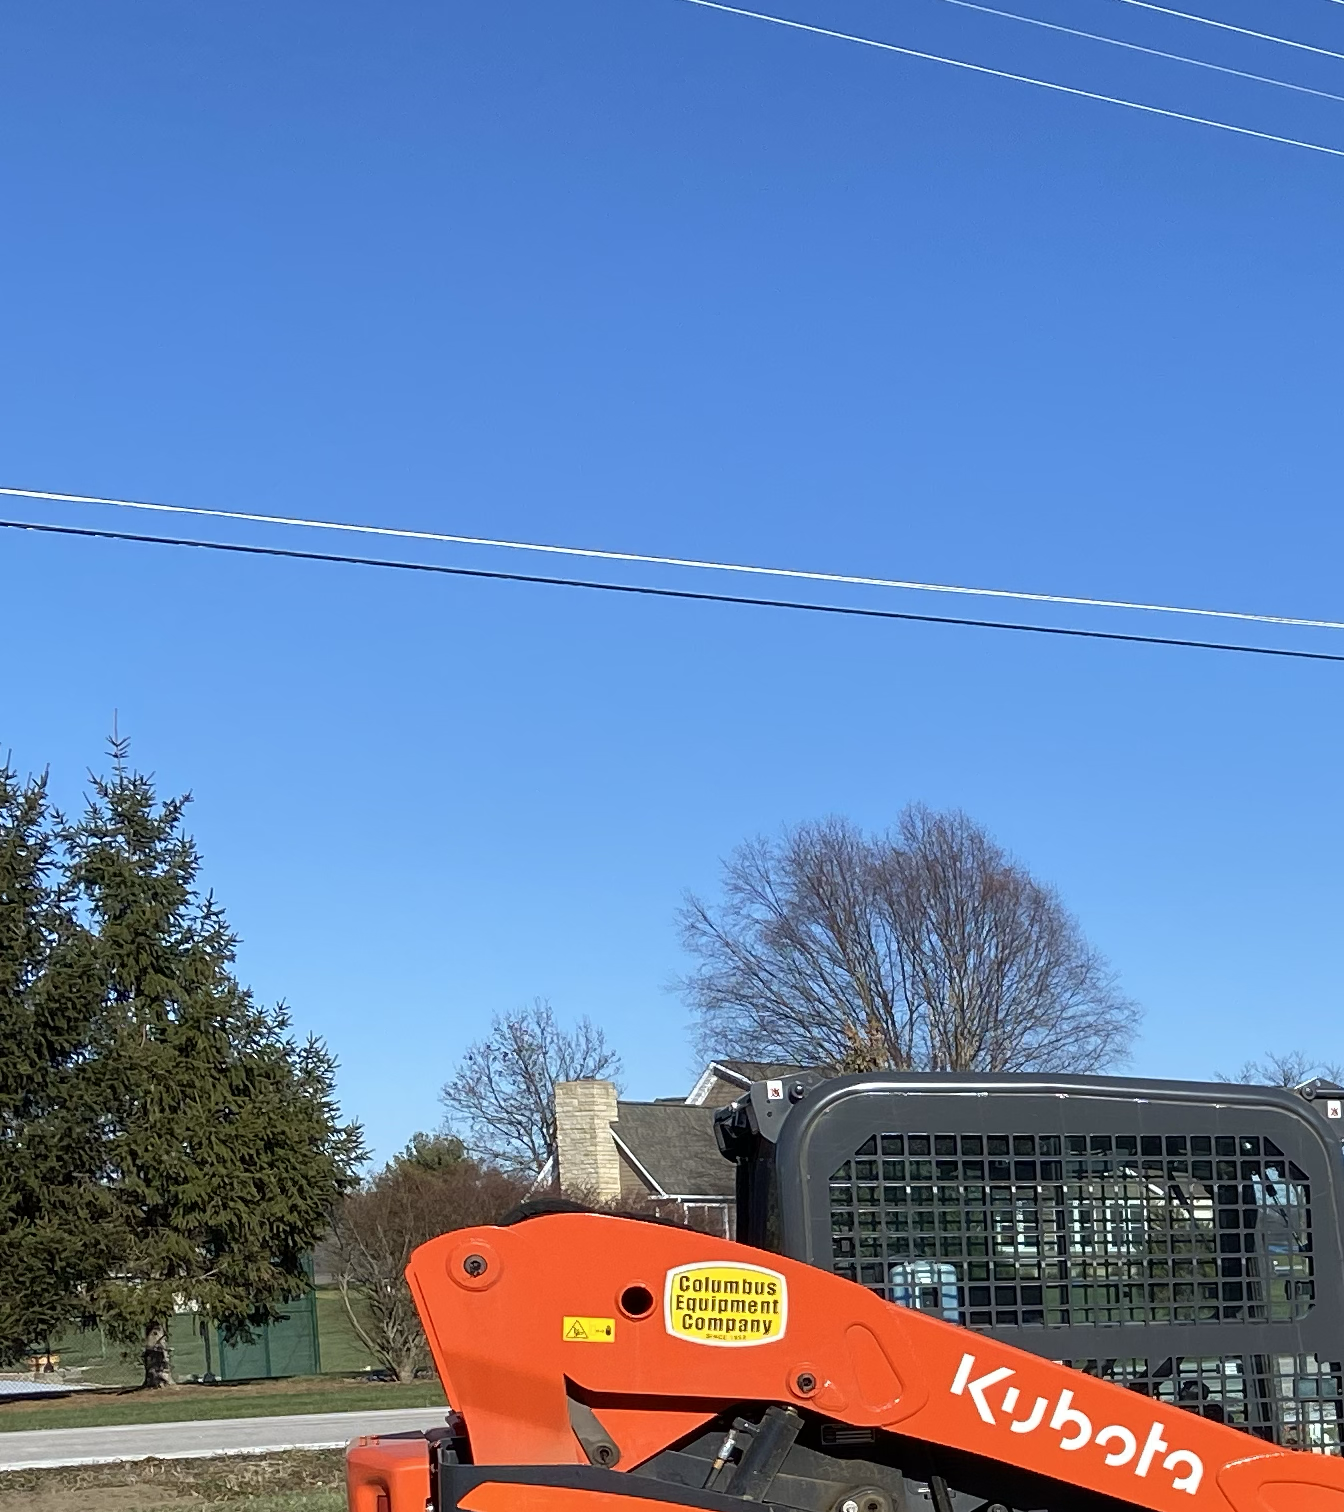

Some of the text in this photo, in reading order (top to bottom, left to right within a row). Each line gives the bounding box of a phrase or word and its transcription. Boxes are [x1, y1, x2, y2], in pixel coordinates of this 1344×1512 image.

[679, 1275, 777, 1296] Columbus
[675, 1294, 779, 1315] Equipment
[682, 1313, 772, 1335] Company
[950, 1353, 1204, 1495] Kubota
